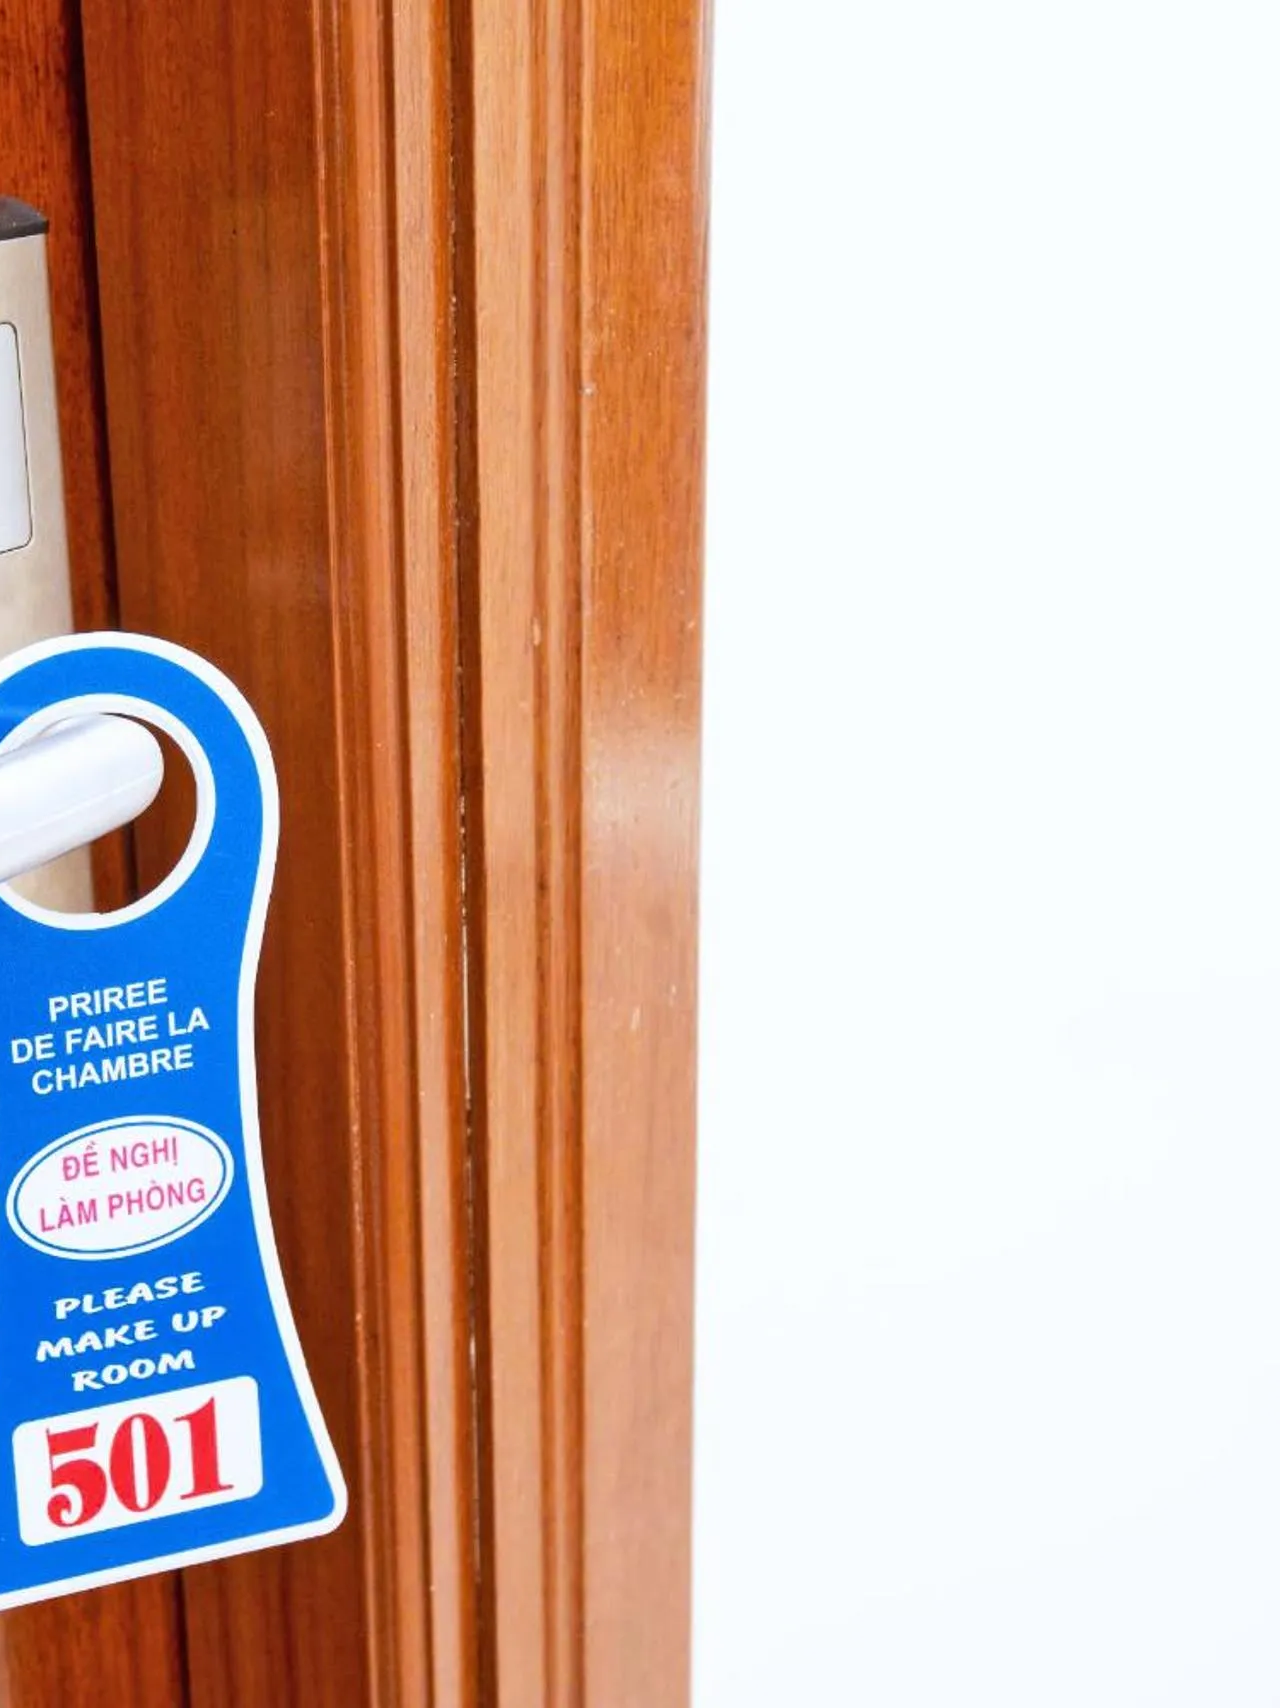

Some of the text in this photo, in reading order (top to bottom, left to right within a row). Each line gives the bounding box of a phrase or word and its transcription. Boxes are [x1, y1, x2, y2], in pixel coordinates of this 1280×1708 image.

[49, 978, 168, 1022] PRIREE
[11, 1007, 210, 1064] DE FAIRE LA
[32, 1044, 194, 1095] CHAMBRE
[62, 1137, 179, 1182] ĐỀ NGHỊ
[39, 1178, 206, 1232] LÀM PHÒNG
[54, 1272, 206, 1320] PLEASE
[36, 1306, 227, 1362] MAKE UP
[73, 1350, 196, 1392] ROOM
[46, 1396, 234, 1528] 501
